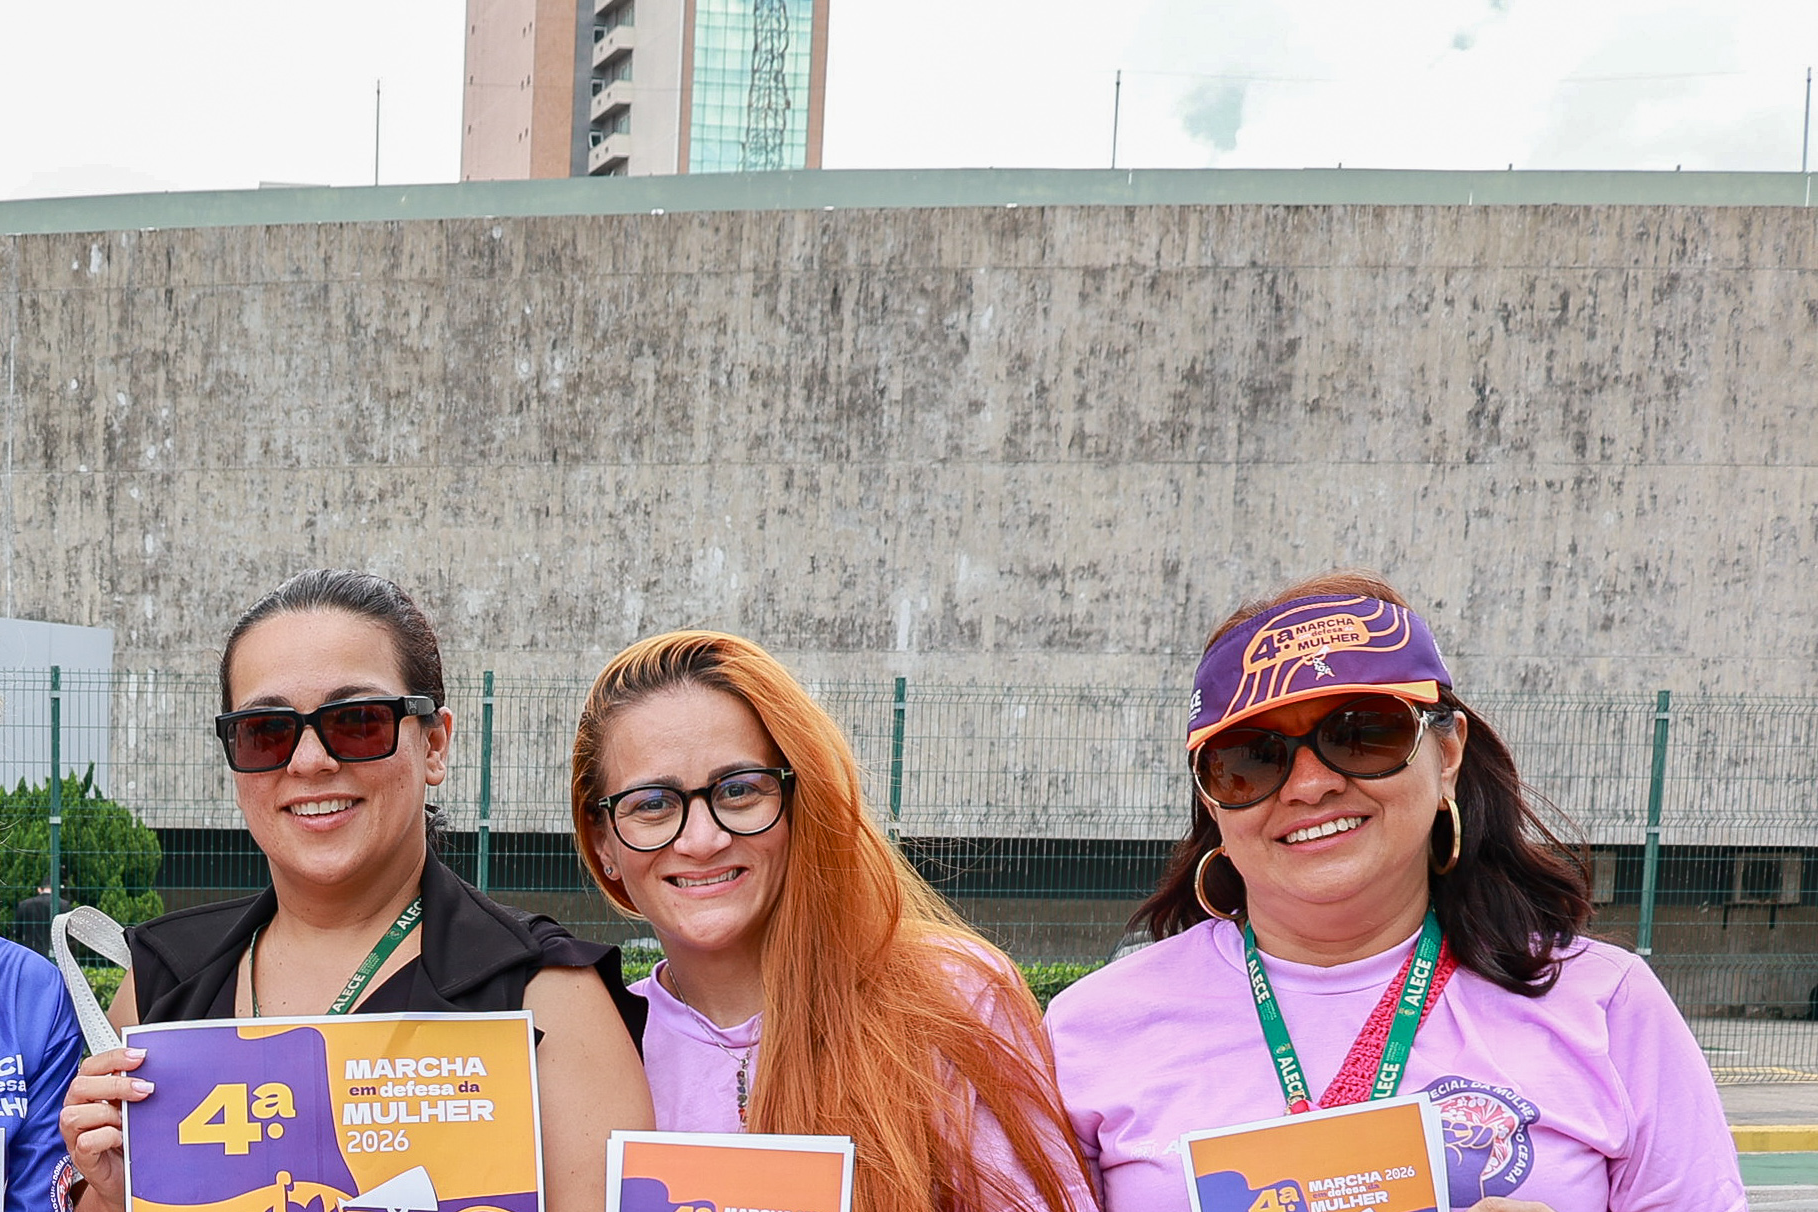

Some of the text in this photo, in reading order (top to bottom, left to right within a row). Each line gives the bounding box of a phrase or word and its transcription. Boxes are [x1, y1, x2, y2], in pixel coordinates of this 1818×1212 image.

[1295, 618, 1355, 634] MARCHA
[1297, 633, 1360, 651] MULHER
[396, 898, 422, 930] ALEC
[332, 973, 366, 1013] ALECE
[1247, 959, 1270, 1004] ALECE
[1404, 958, 1432, 1007] ALECE
[344, 1056, 488, 1080] MARCHA
[349, 1081, 481, 1098] em defesa da
[341, 1098, 495, 1126] MULHER
[346, 1129, 410, 1154] 2026
[1308, 1165, 1416, 1193] MARCHA 2026
